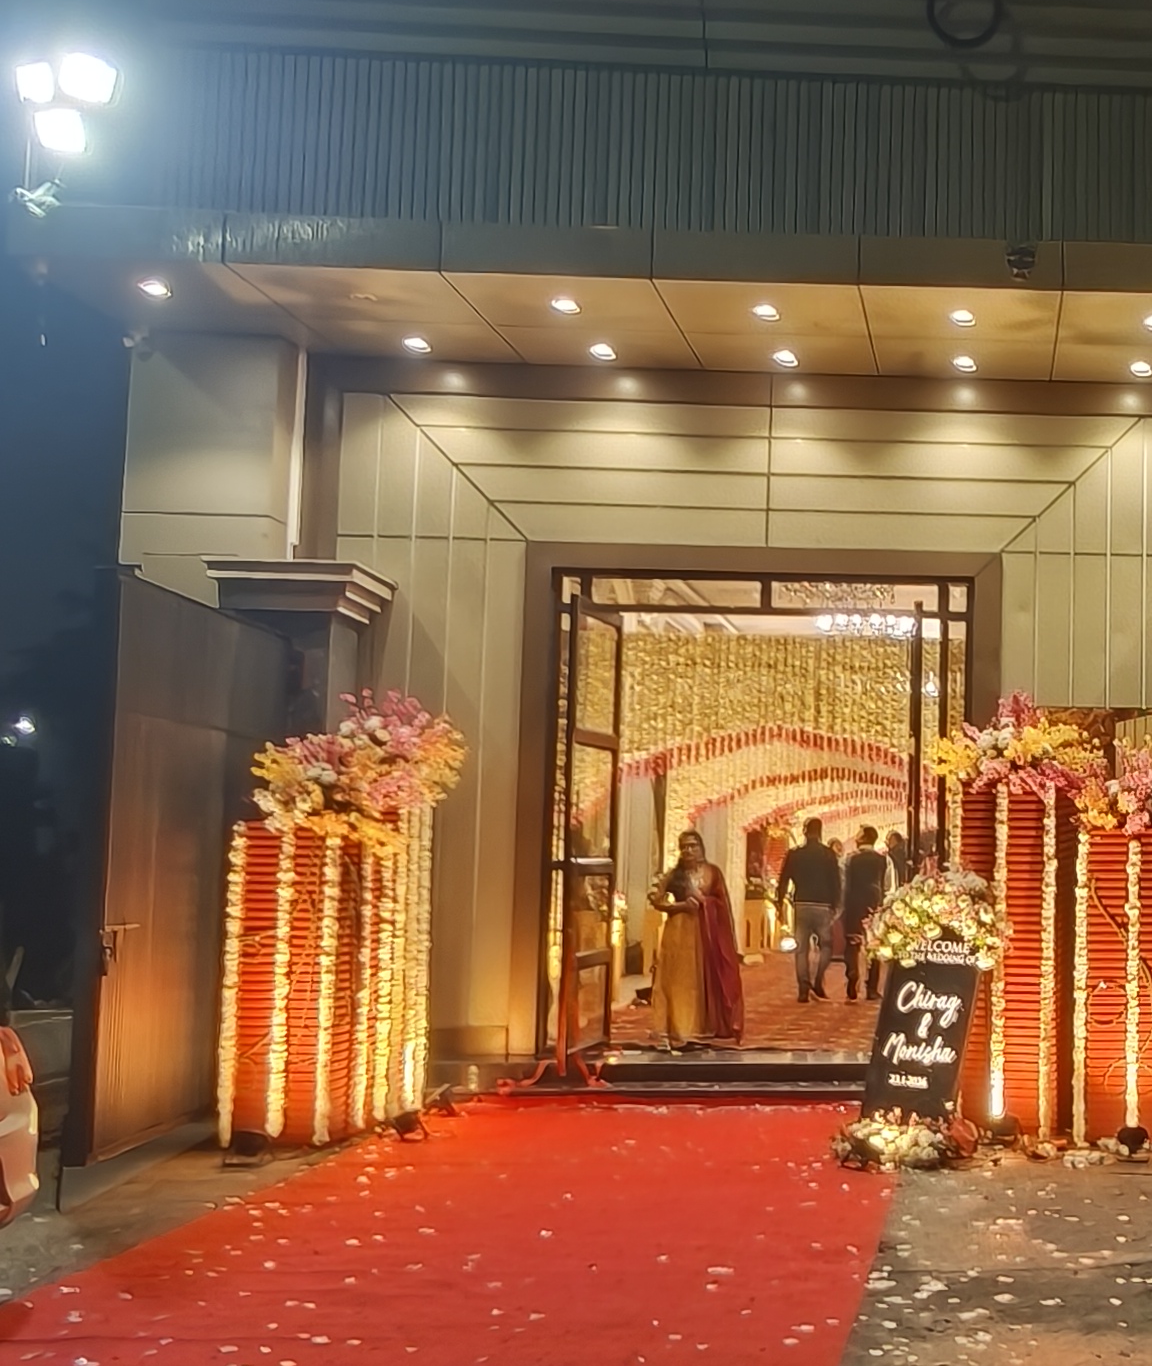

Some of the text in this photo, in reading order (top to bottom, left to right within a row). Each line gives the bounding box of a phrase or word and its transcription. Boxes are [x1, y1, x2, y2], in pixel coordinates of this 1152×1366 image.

[896, 980, 962, 1029] Chirag
[917, 1012, 933, 1039] &
[881, 1032, 957, 1066] Monisha
